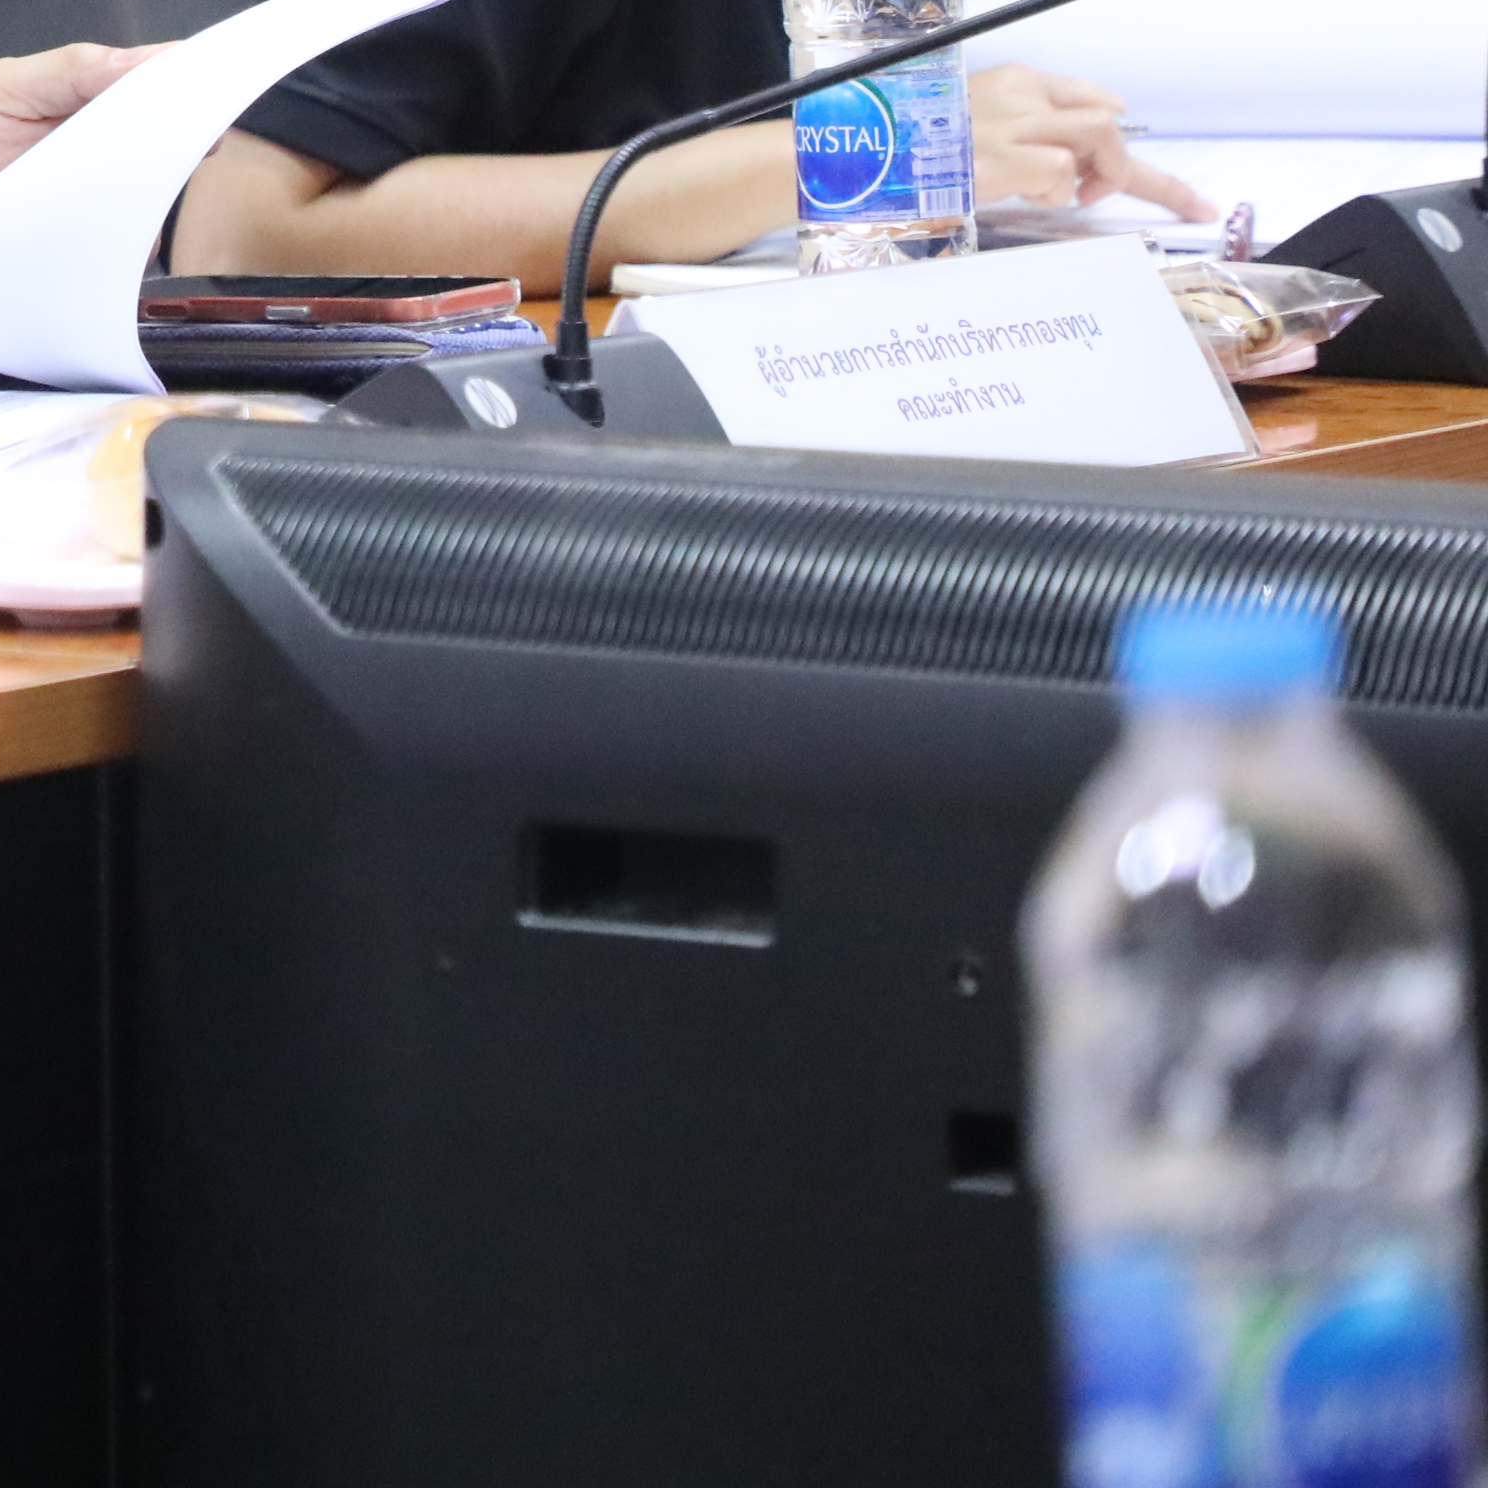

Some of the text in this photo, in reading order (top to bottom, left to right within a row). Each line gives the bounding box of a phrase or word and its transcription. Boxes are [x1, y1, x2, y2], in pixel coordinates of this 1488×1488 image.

[754, 312, 1103, 399] ผู้อำนวยการสำนักบริหารกองทุน
[896, 377, 1026, 423] คณะทำงาน
